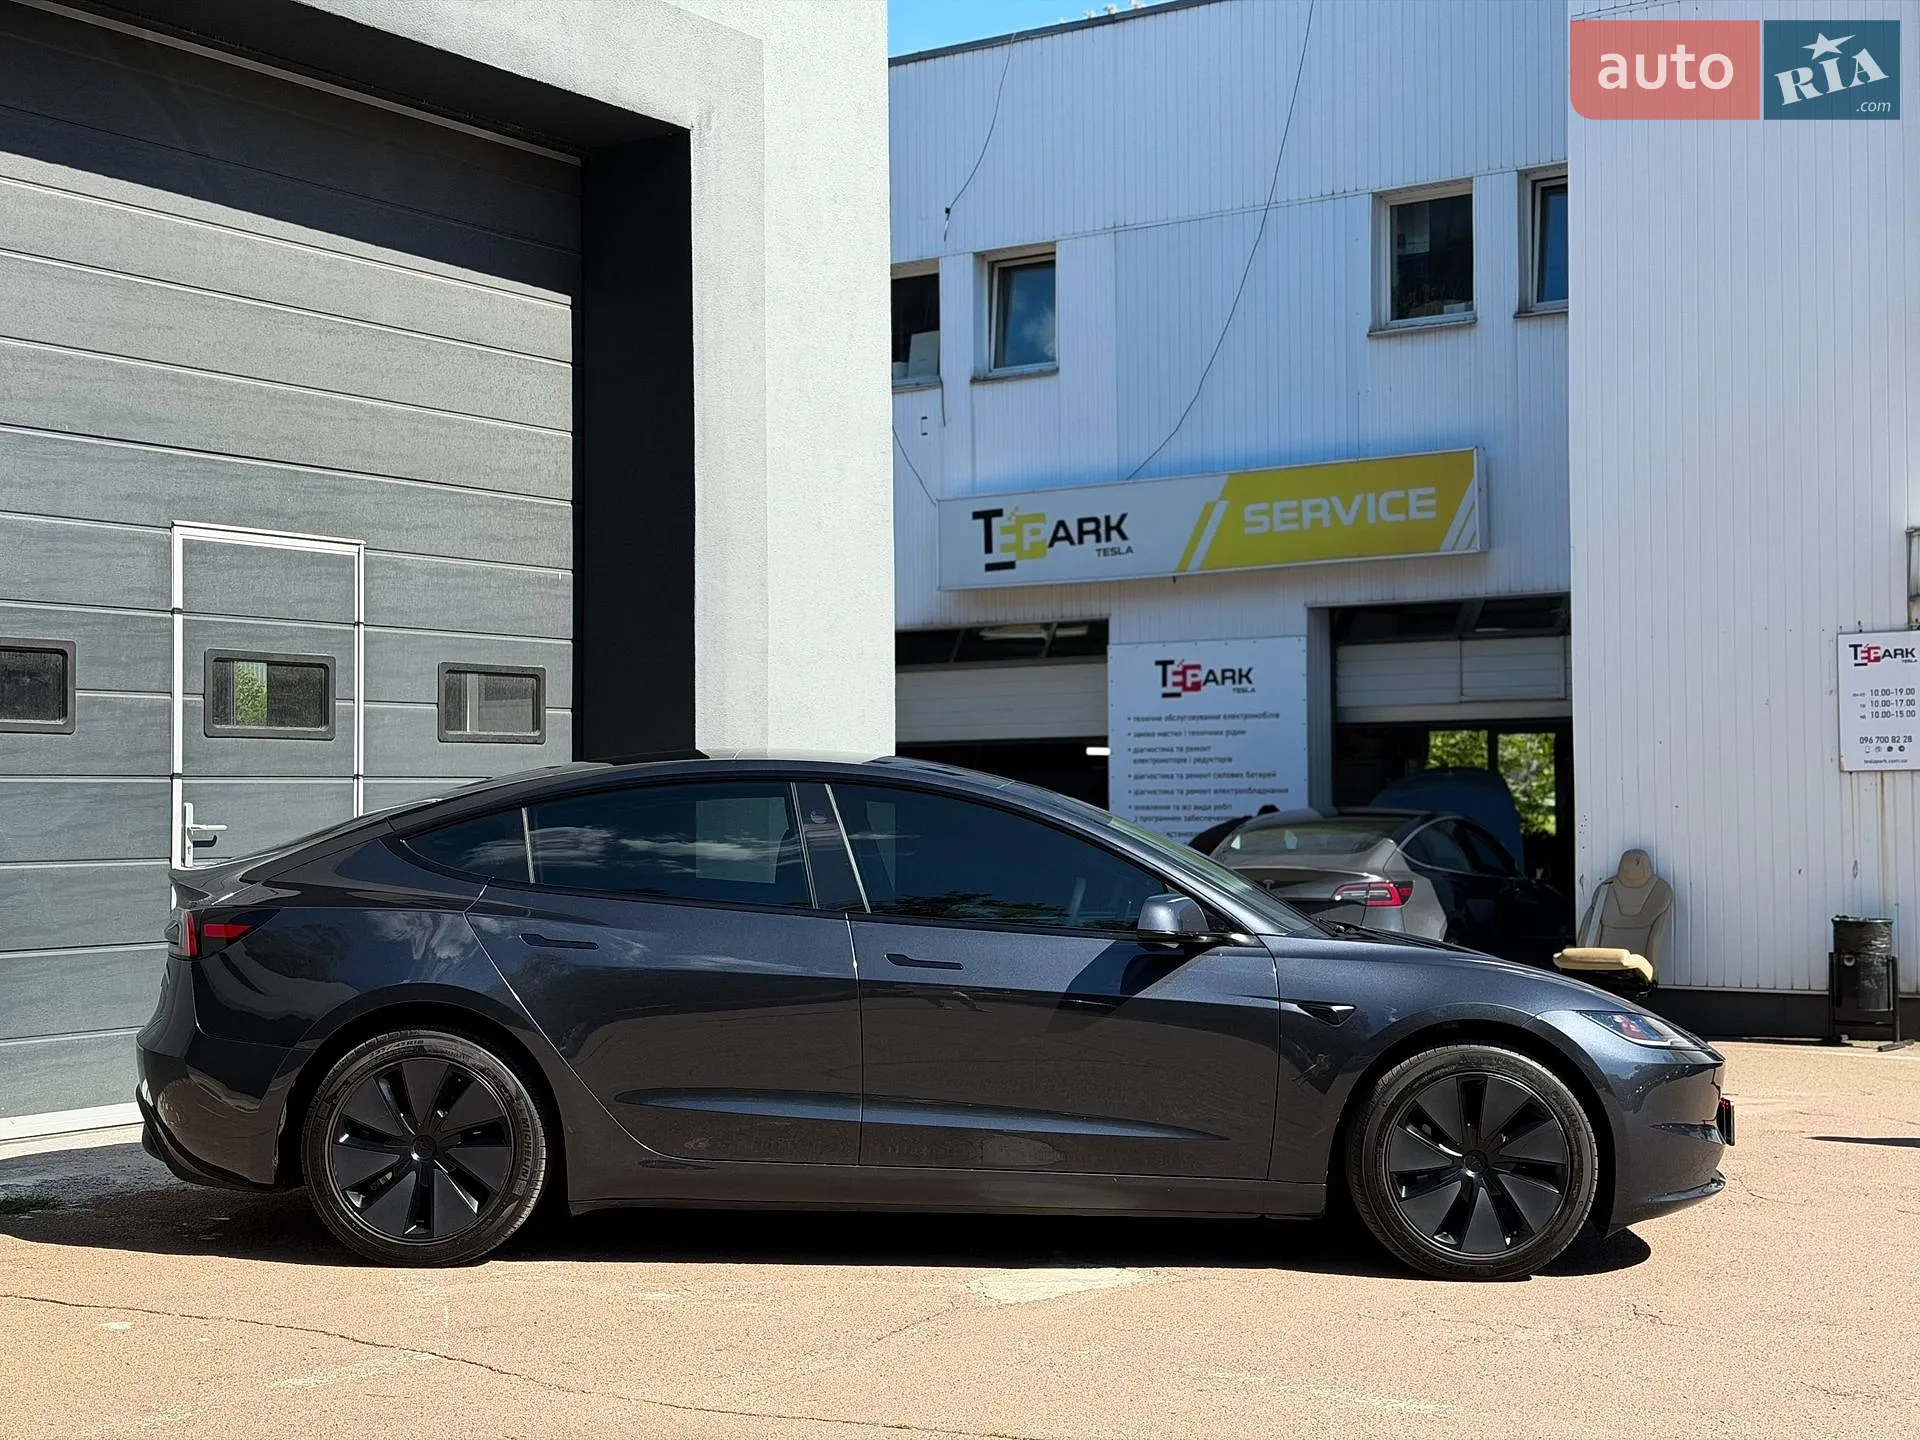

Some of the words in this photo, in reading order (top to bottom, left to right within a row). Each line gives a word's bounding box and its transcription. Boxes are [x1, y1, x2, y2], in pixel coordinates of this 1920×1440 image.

[1244, 487, 1437, 535] SERVICE
[1096, 546, 1134, 557] TESLA
[1870, 688, 1915, 696] 10.00-19.00
[1870, 699, 1916, 708] 10.00-17.00
[1871, 710, 1916, 718] 10.00-15.00
[1859, 736, 1873, 744] 096
[1876, 736, 1889, 744] 700
